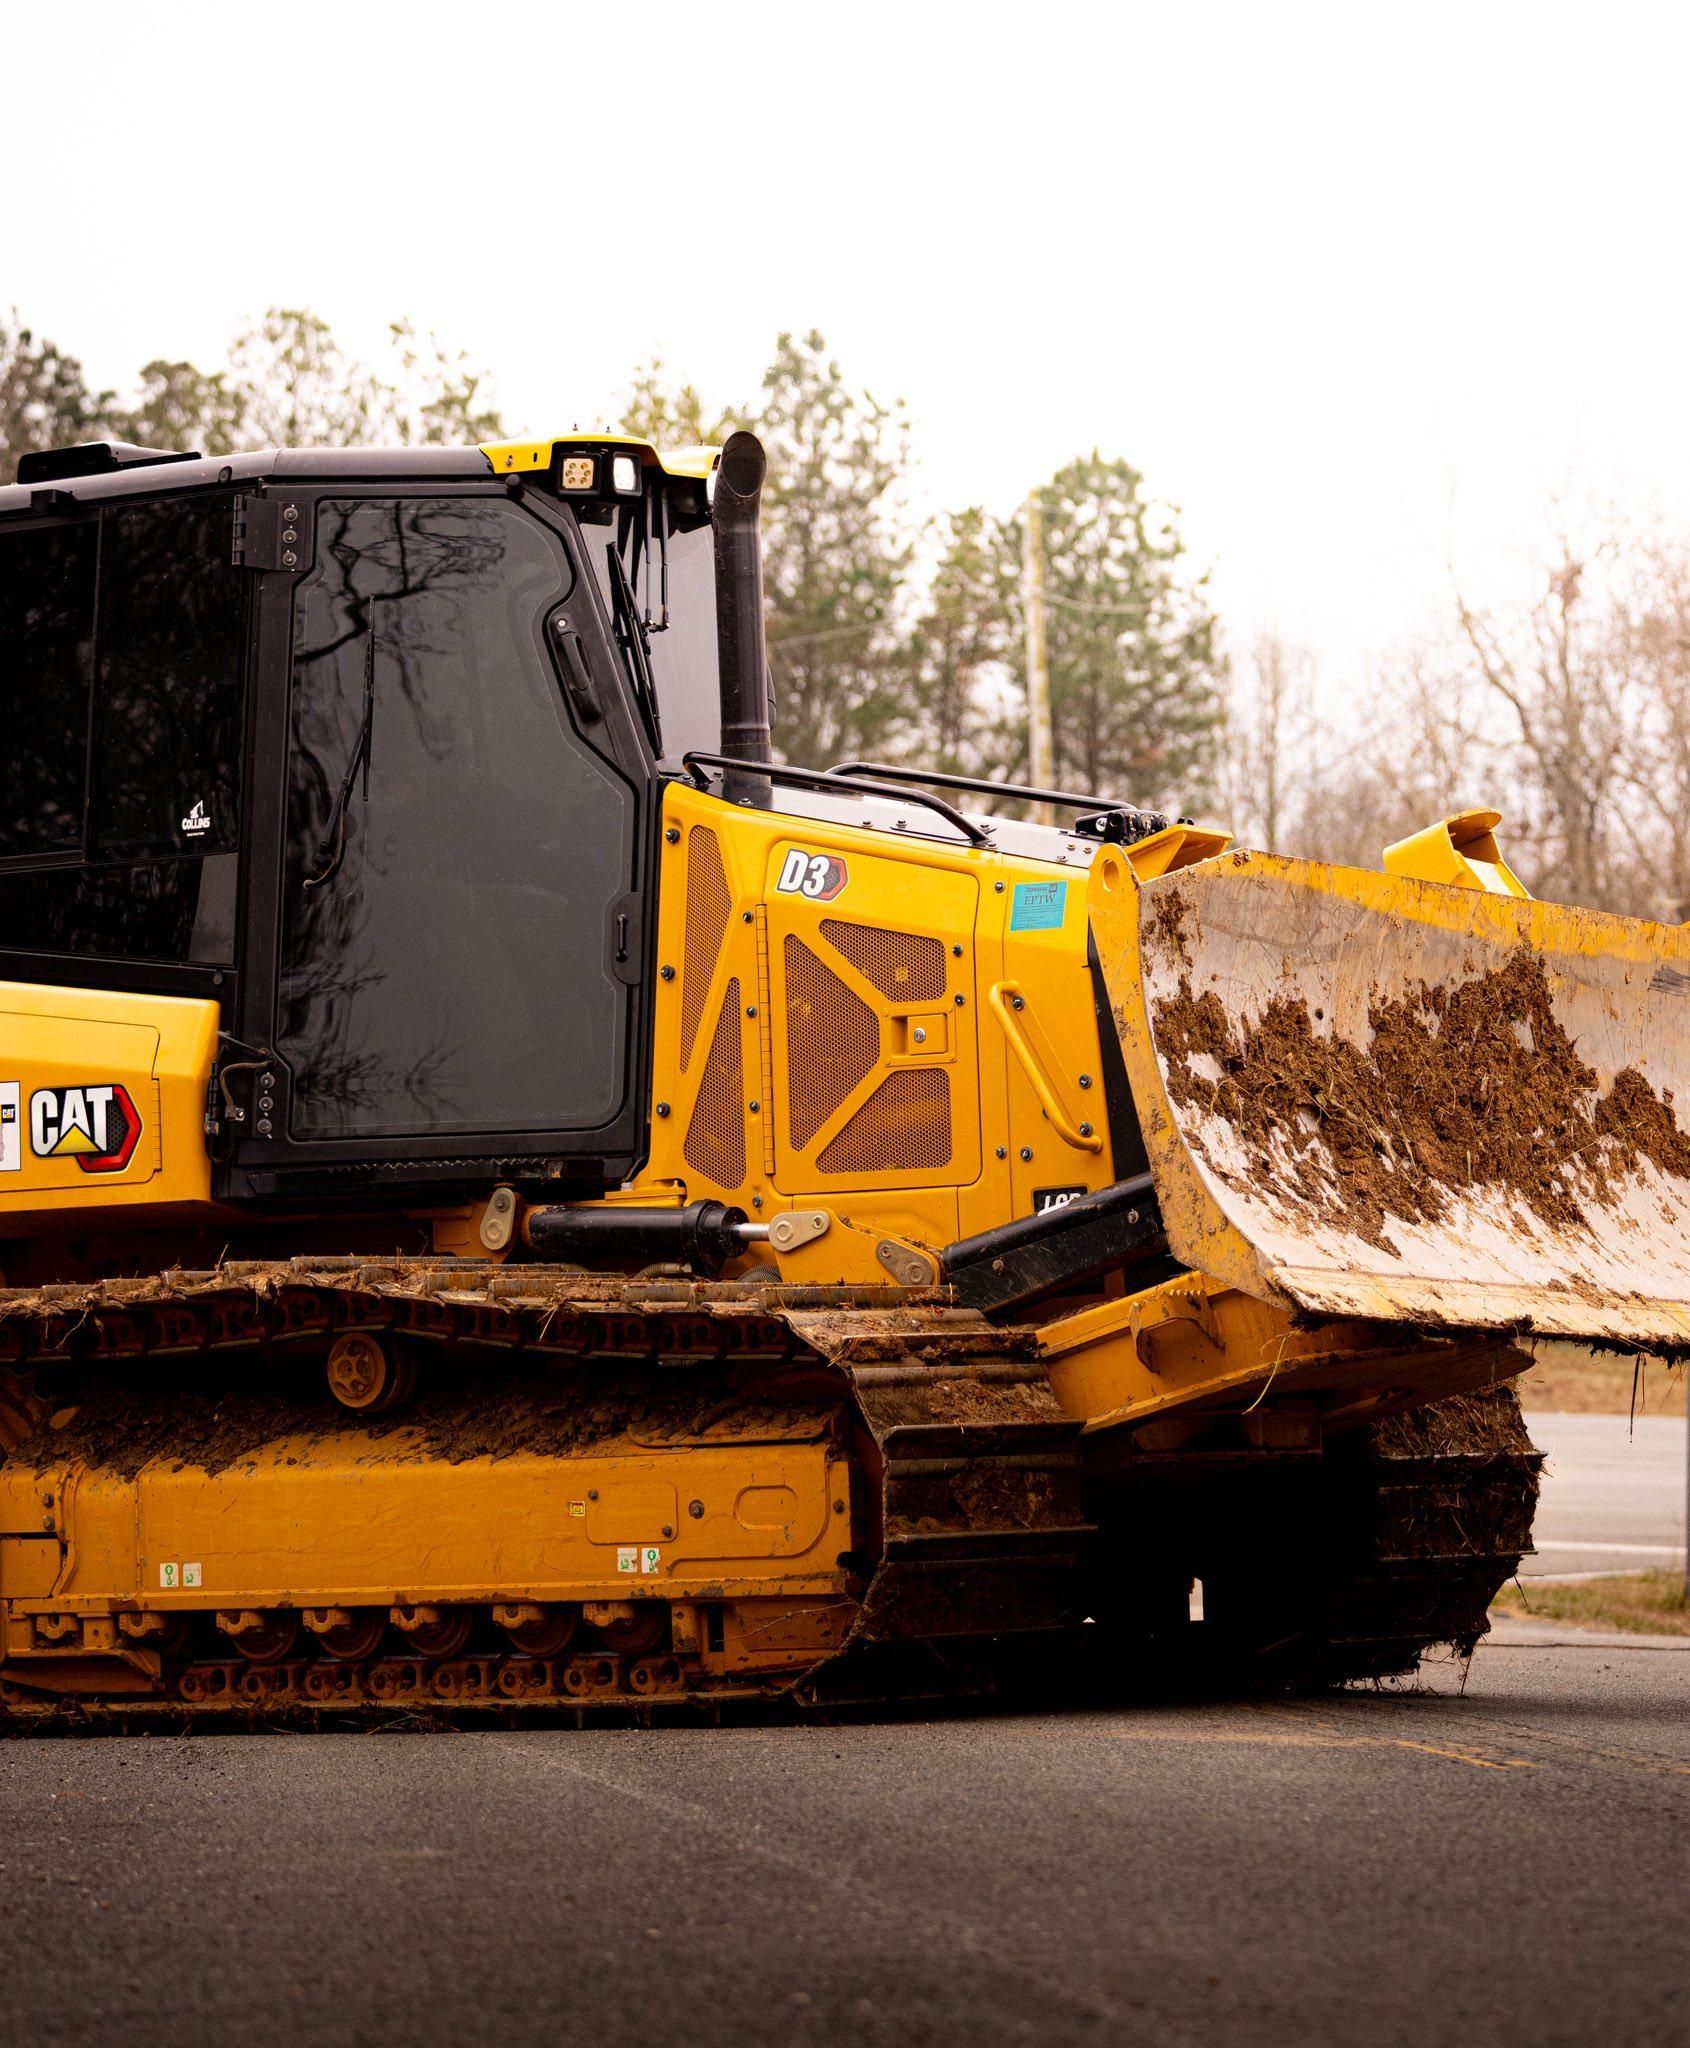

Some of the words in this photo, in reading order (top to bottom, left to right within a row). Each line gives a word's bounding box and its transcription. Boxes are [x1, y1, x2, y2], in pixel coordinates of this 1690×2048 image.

[778, 850, 830, 896] D3
[1024, 893, 1056, 905] EPTW
[2, 1108, 14, 1119] CAT
[30, 1086, 113, 1156] CAT
